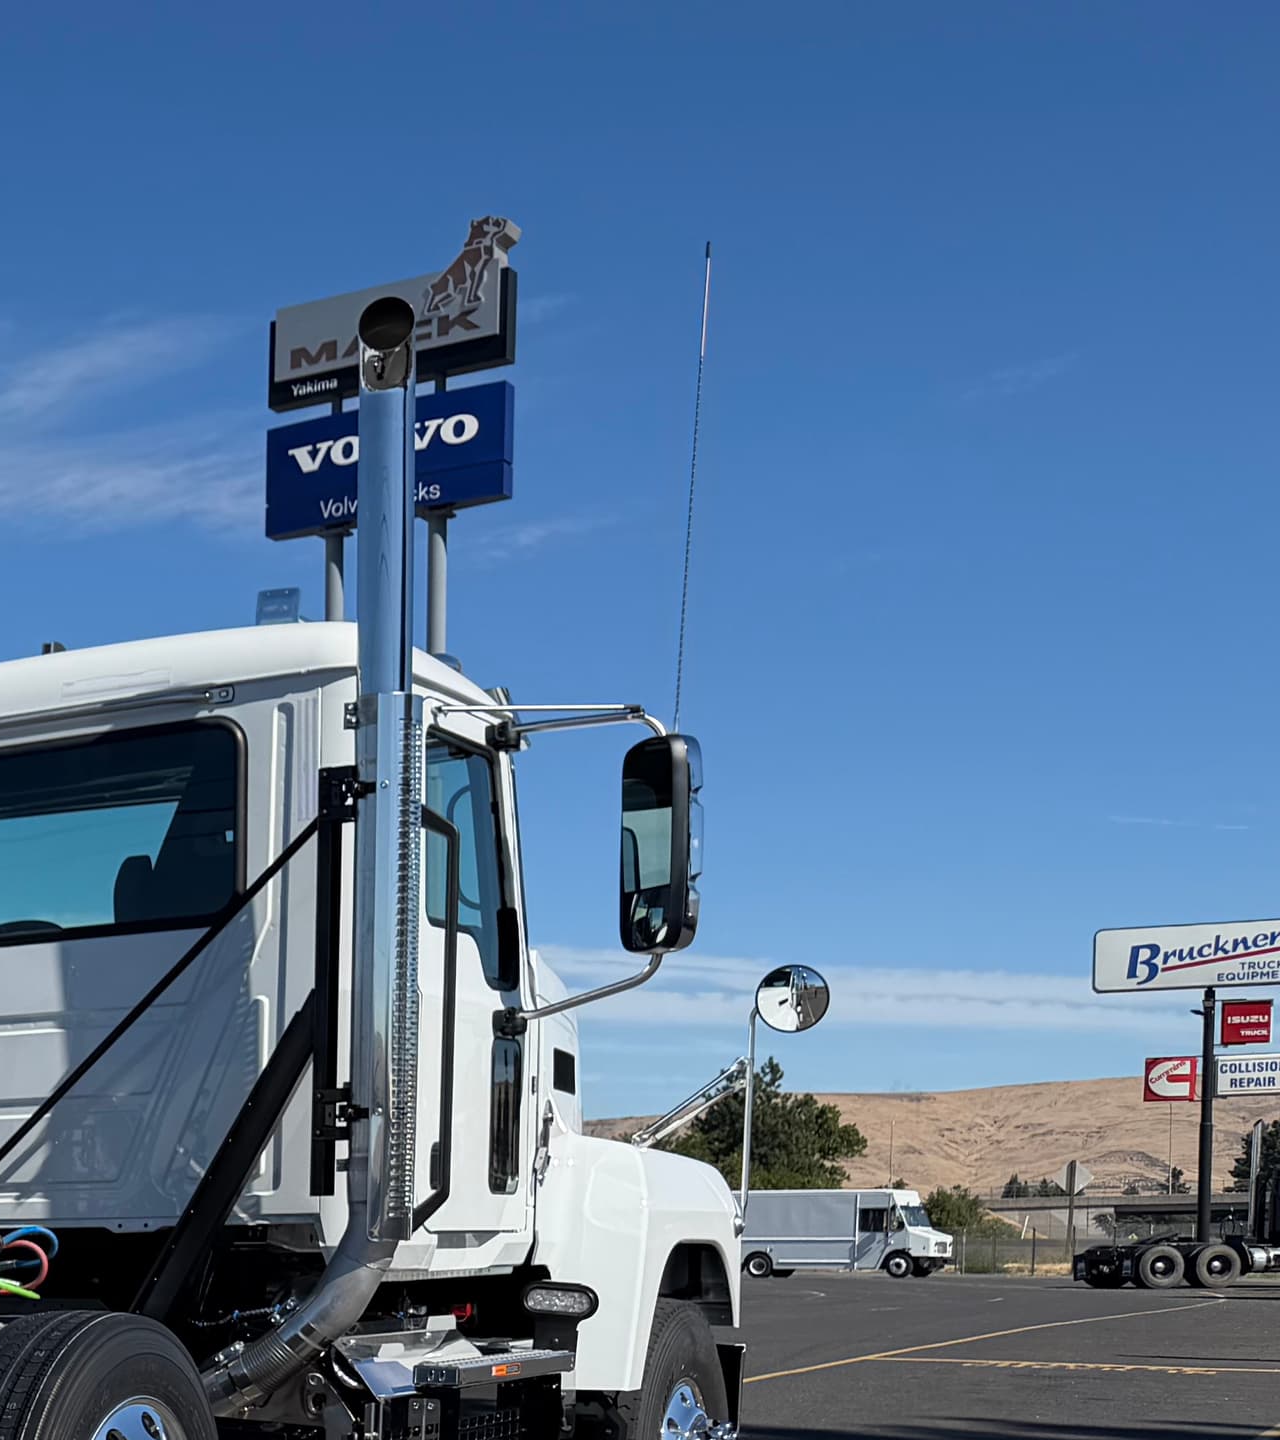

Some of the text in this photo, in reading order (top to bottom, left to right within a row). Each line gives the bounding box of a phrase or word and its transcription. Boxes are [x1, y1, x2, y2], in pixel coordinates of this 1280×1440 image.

[291, 377, 338, 397] Yakima
[288, 413, 479, 474] VOVO
[320, 495, 358, 519] Volv
[1227, 1015, 1269, 1024] ISUZU
[1220, 1061, 1280, 1074] COLLISIO
[1230, 1076, 1276, 1088] REPAIR
